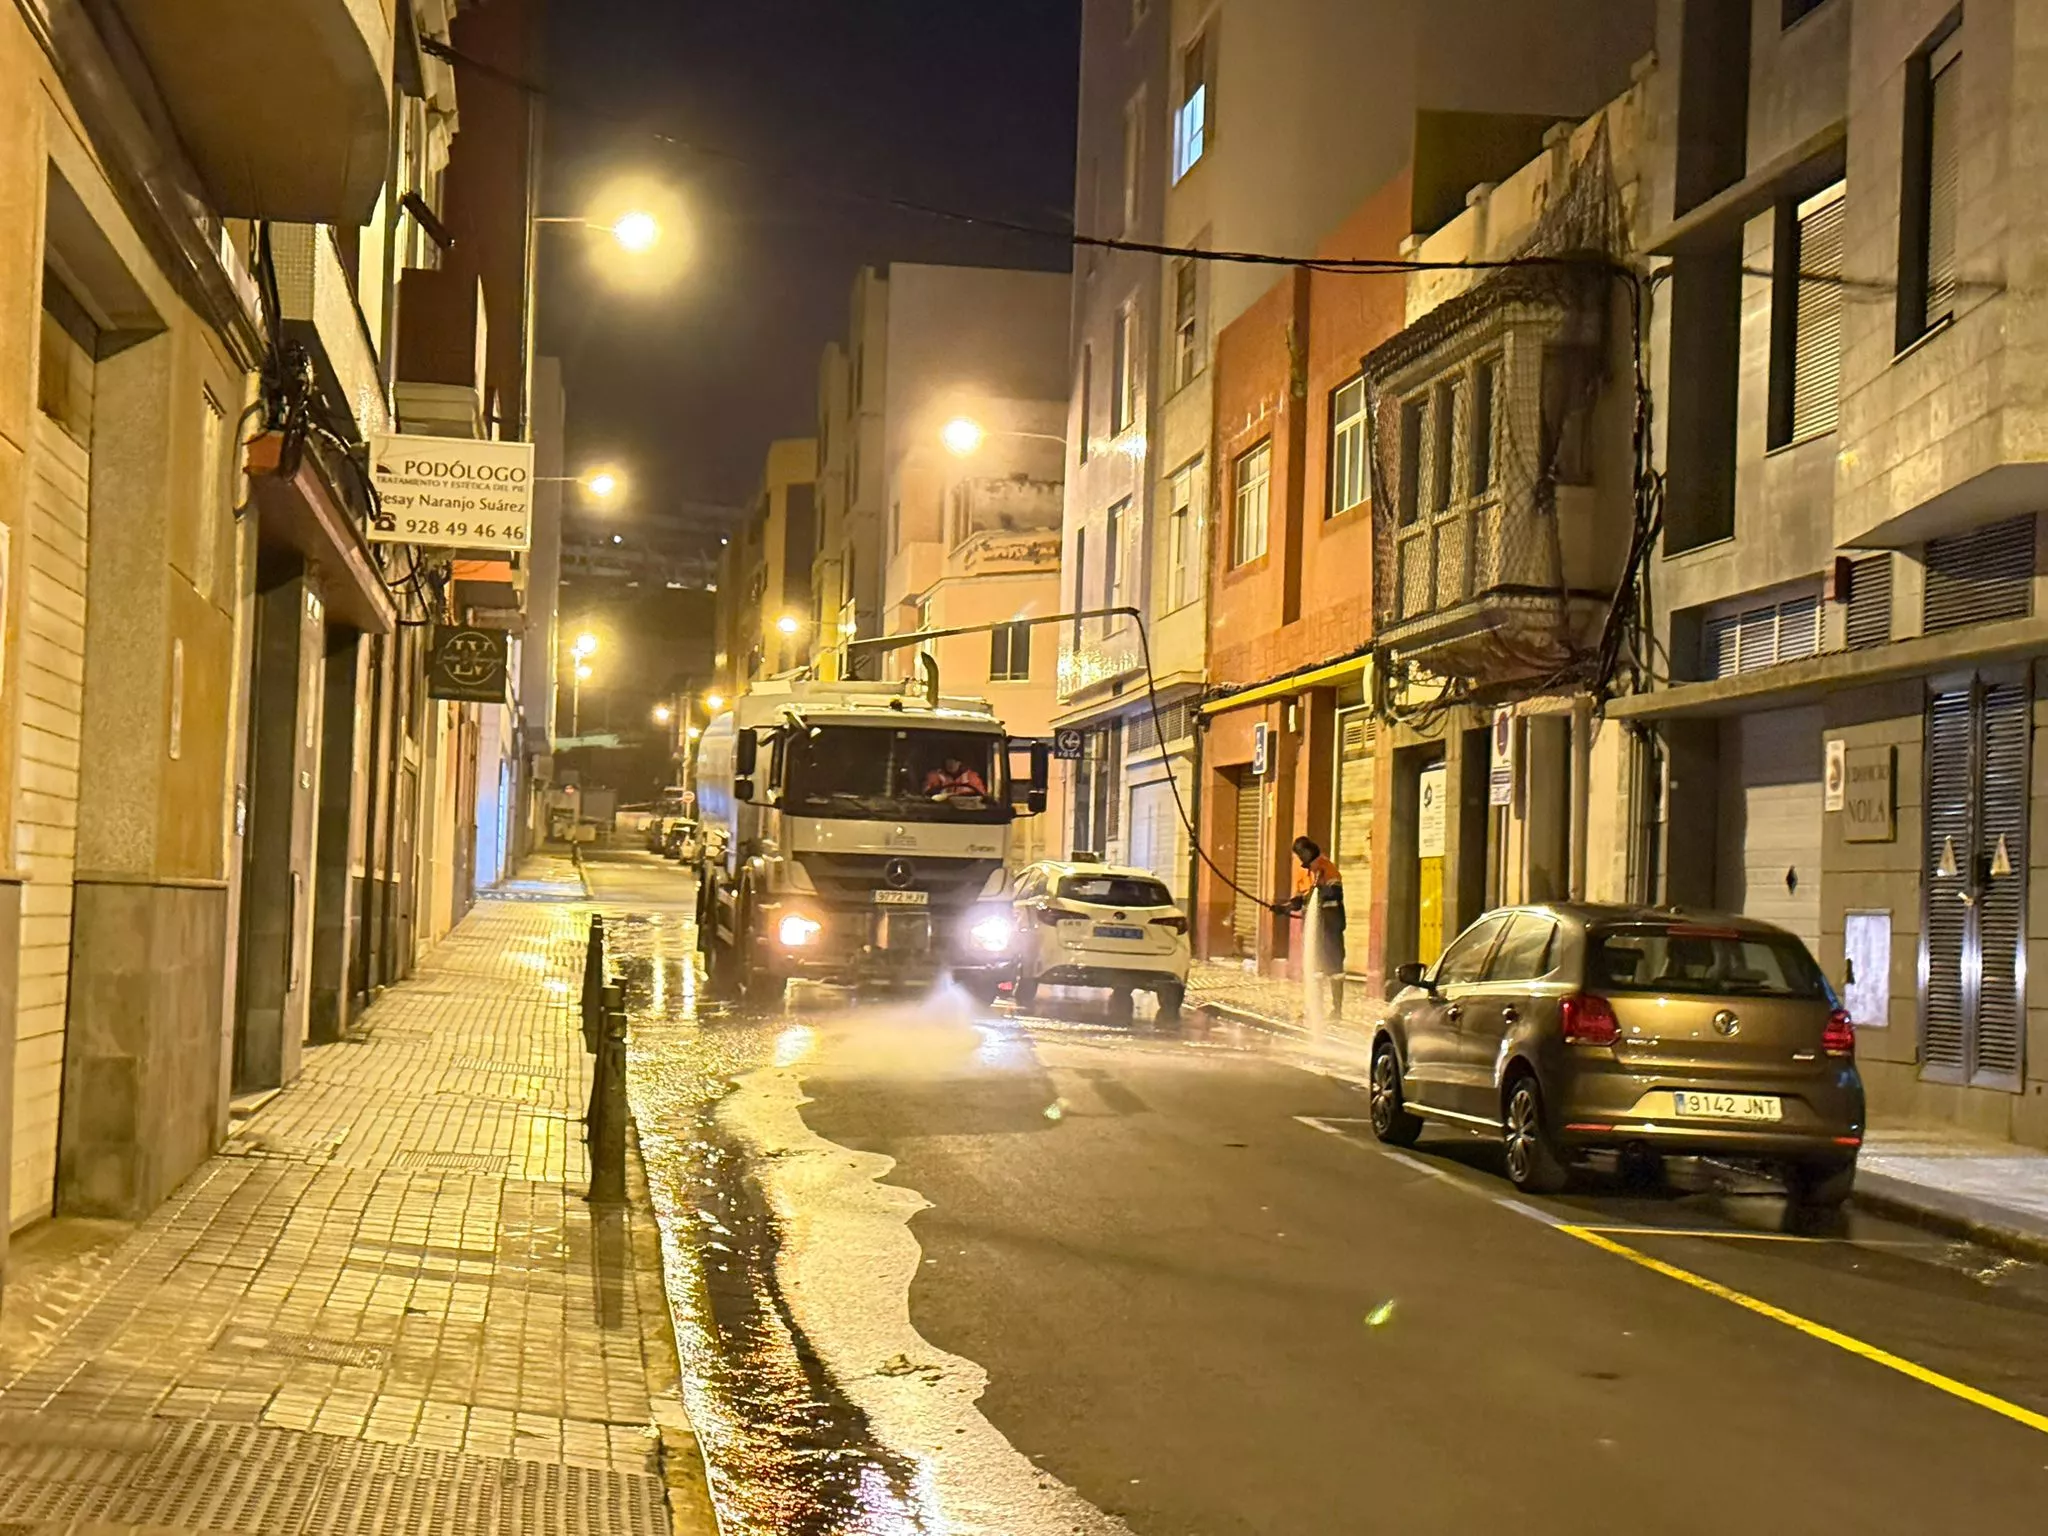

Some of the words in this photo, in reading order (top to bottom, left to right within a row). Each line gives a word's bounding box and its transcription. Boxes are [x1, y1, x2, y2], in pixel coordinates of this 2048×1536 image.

[405, 460, 526, 483] PODÓLOGO
[376, 476, 441, 487] TRATAMIENTO
[442, 480, 449, 488] Y
[419, 494, 475, 512] Naranjo
[479, 497, 525, 513] Suárez
[406, 519, 440, 534] 928
[445, 522, 468, 537] 49
[473, 524, 496, 538] 46
[502, 525, 524, 540] 46
[1689, 1096, 1736, 1113] 9142
[1743, 1099, 1773, 1116] JNT
